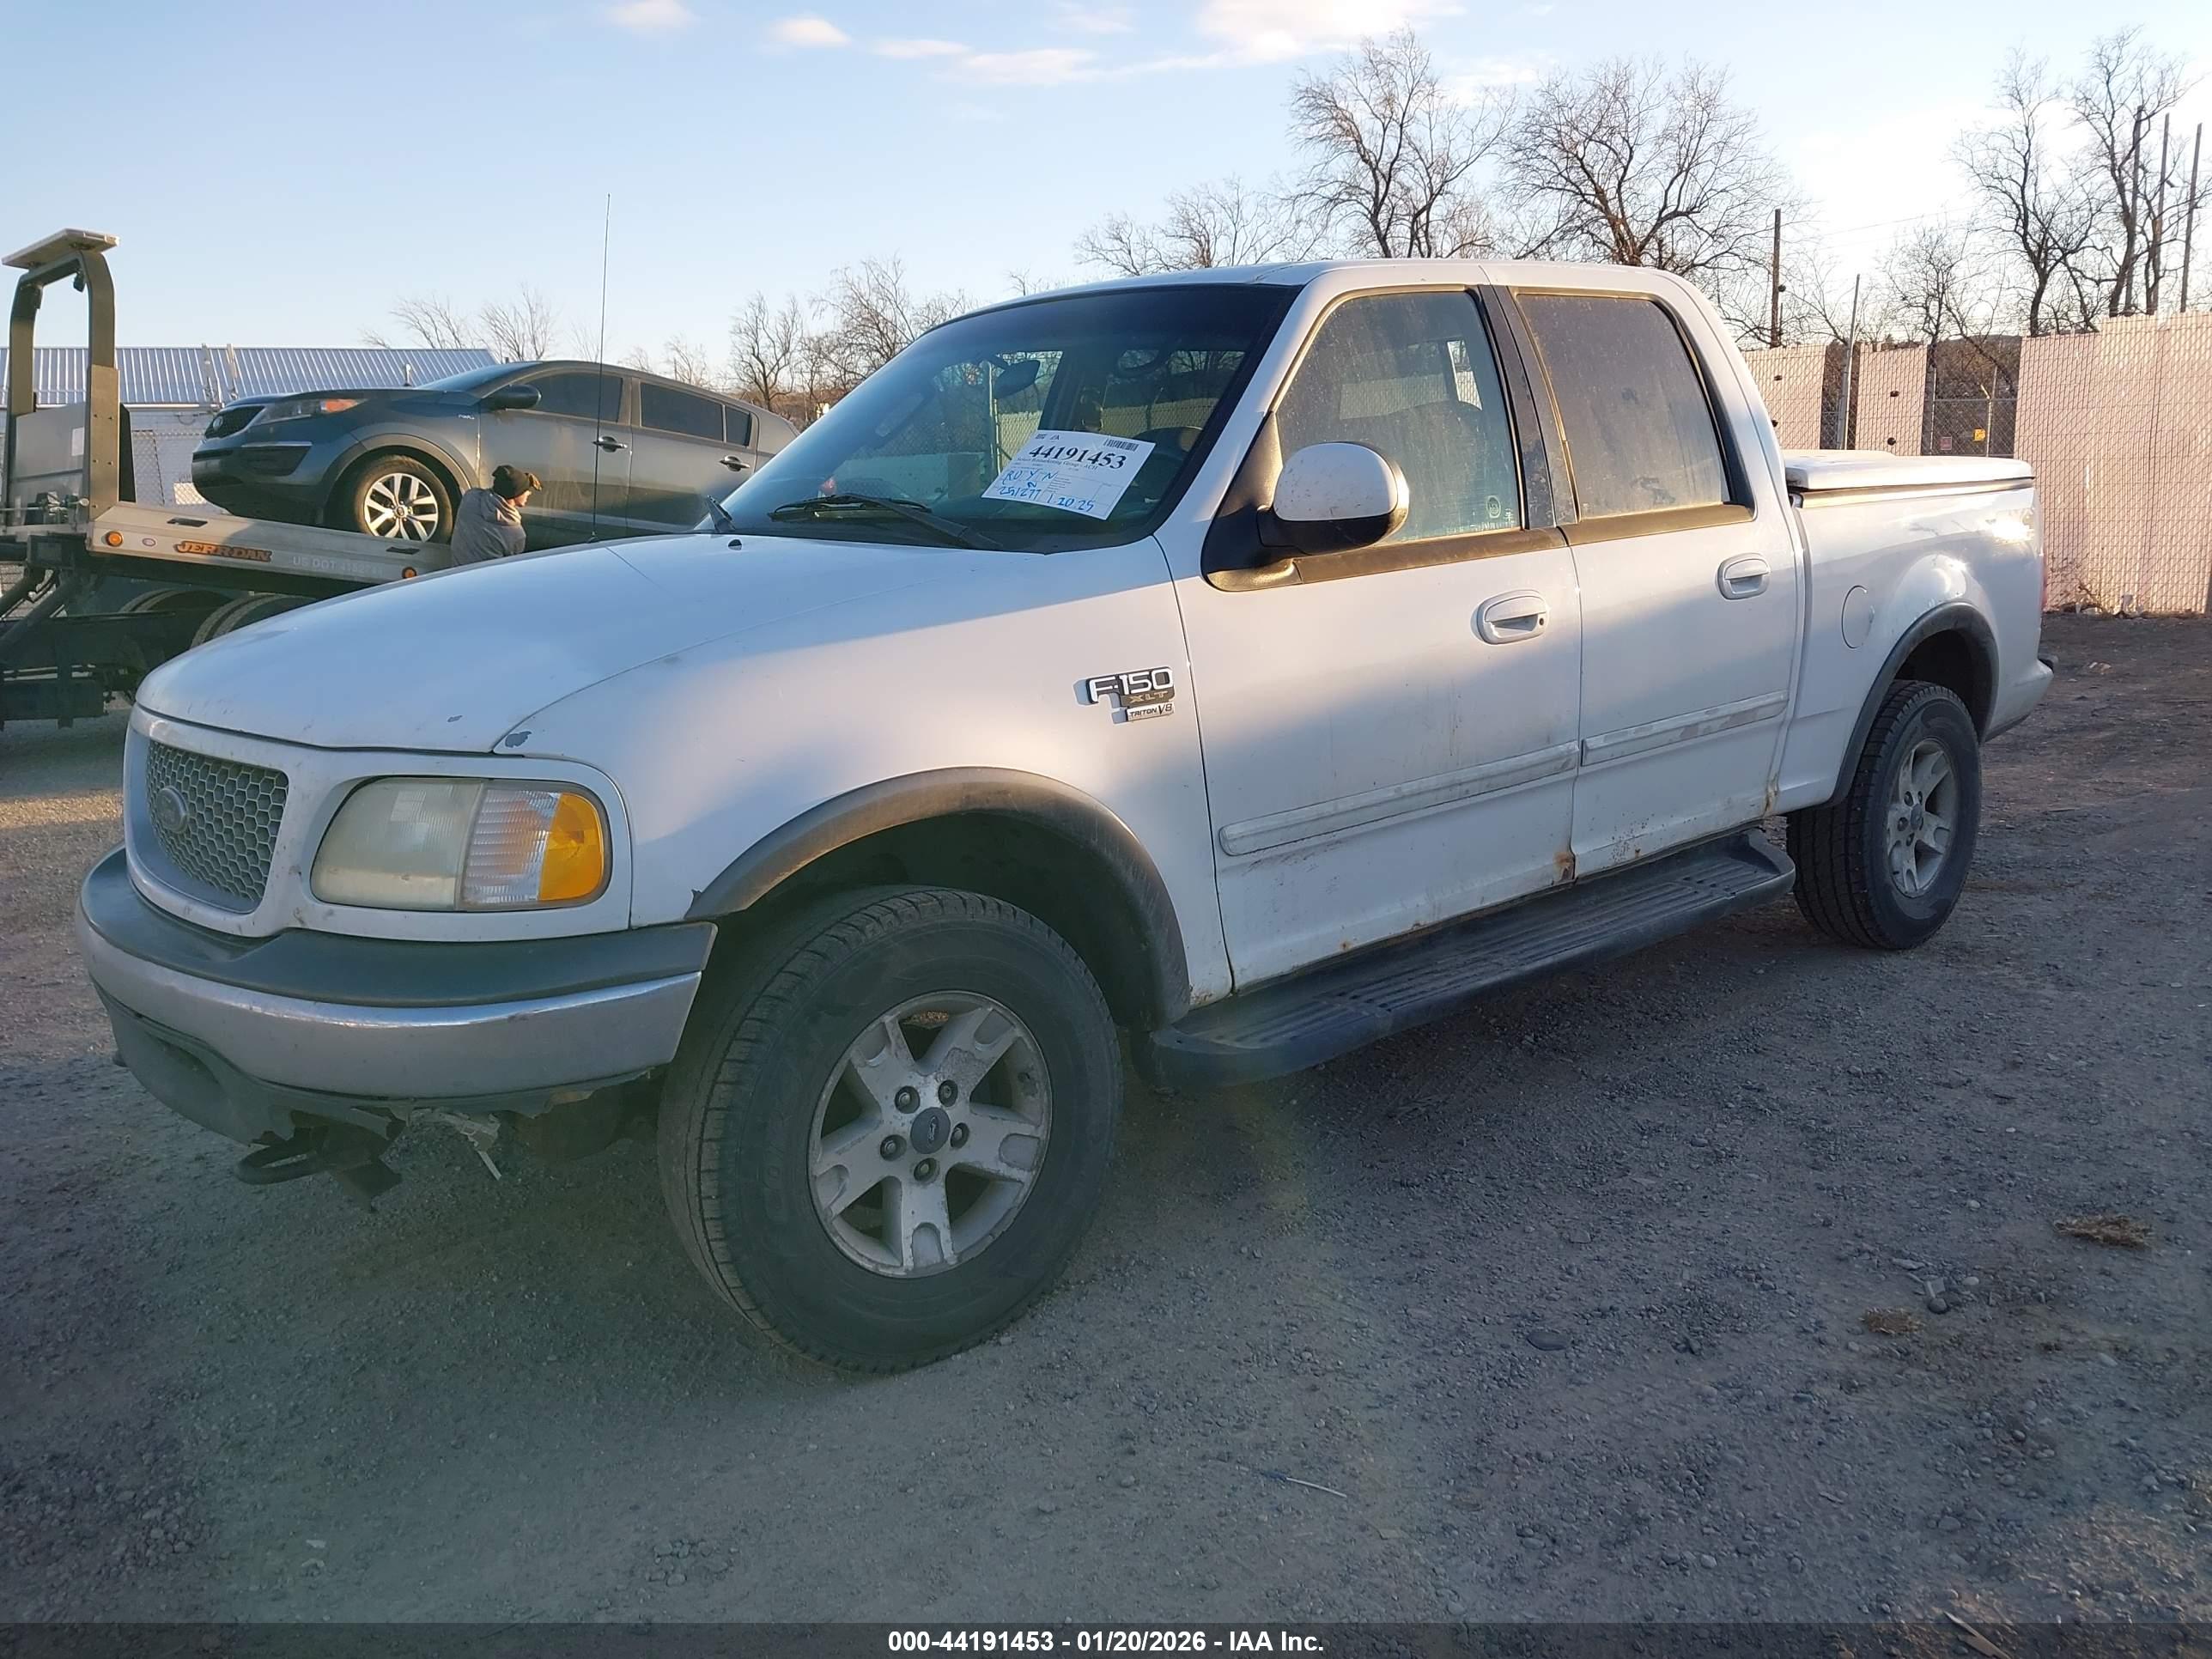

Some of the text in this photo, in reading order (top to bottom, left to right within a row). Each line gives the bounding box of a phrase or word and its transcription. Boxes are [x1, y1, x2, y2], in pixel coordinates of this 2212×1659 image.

[1029, 445, 1127, 469] 44191453
[312, 557, 337, 570] DOT
[1089, 669, 1174, 702] F-150
[1128, 690, 1168, 703] XLT
[1129, 703, 1173, 717] TRITON V8
